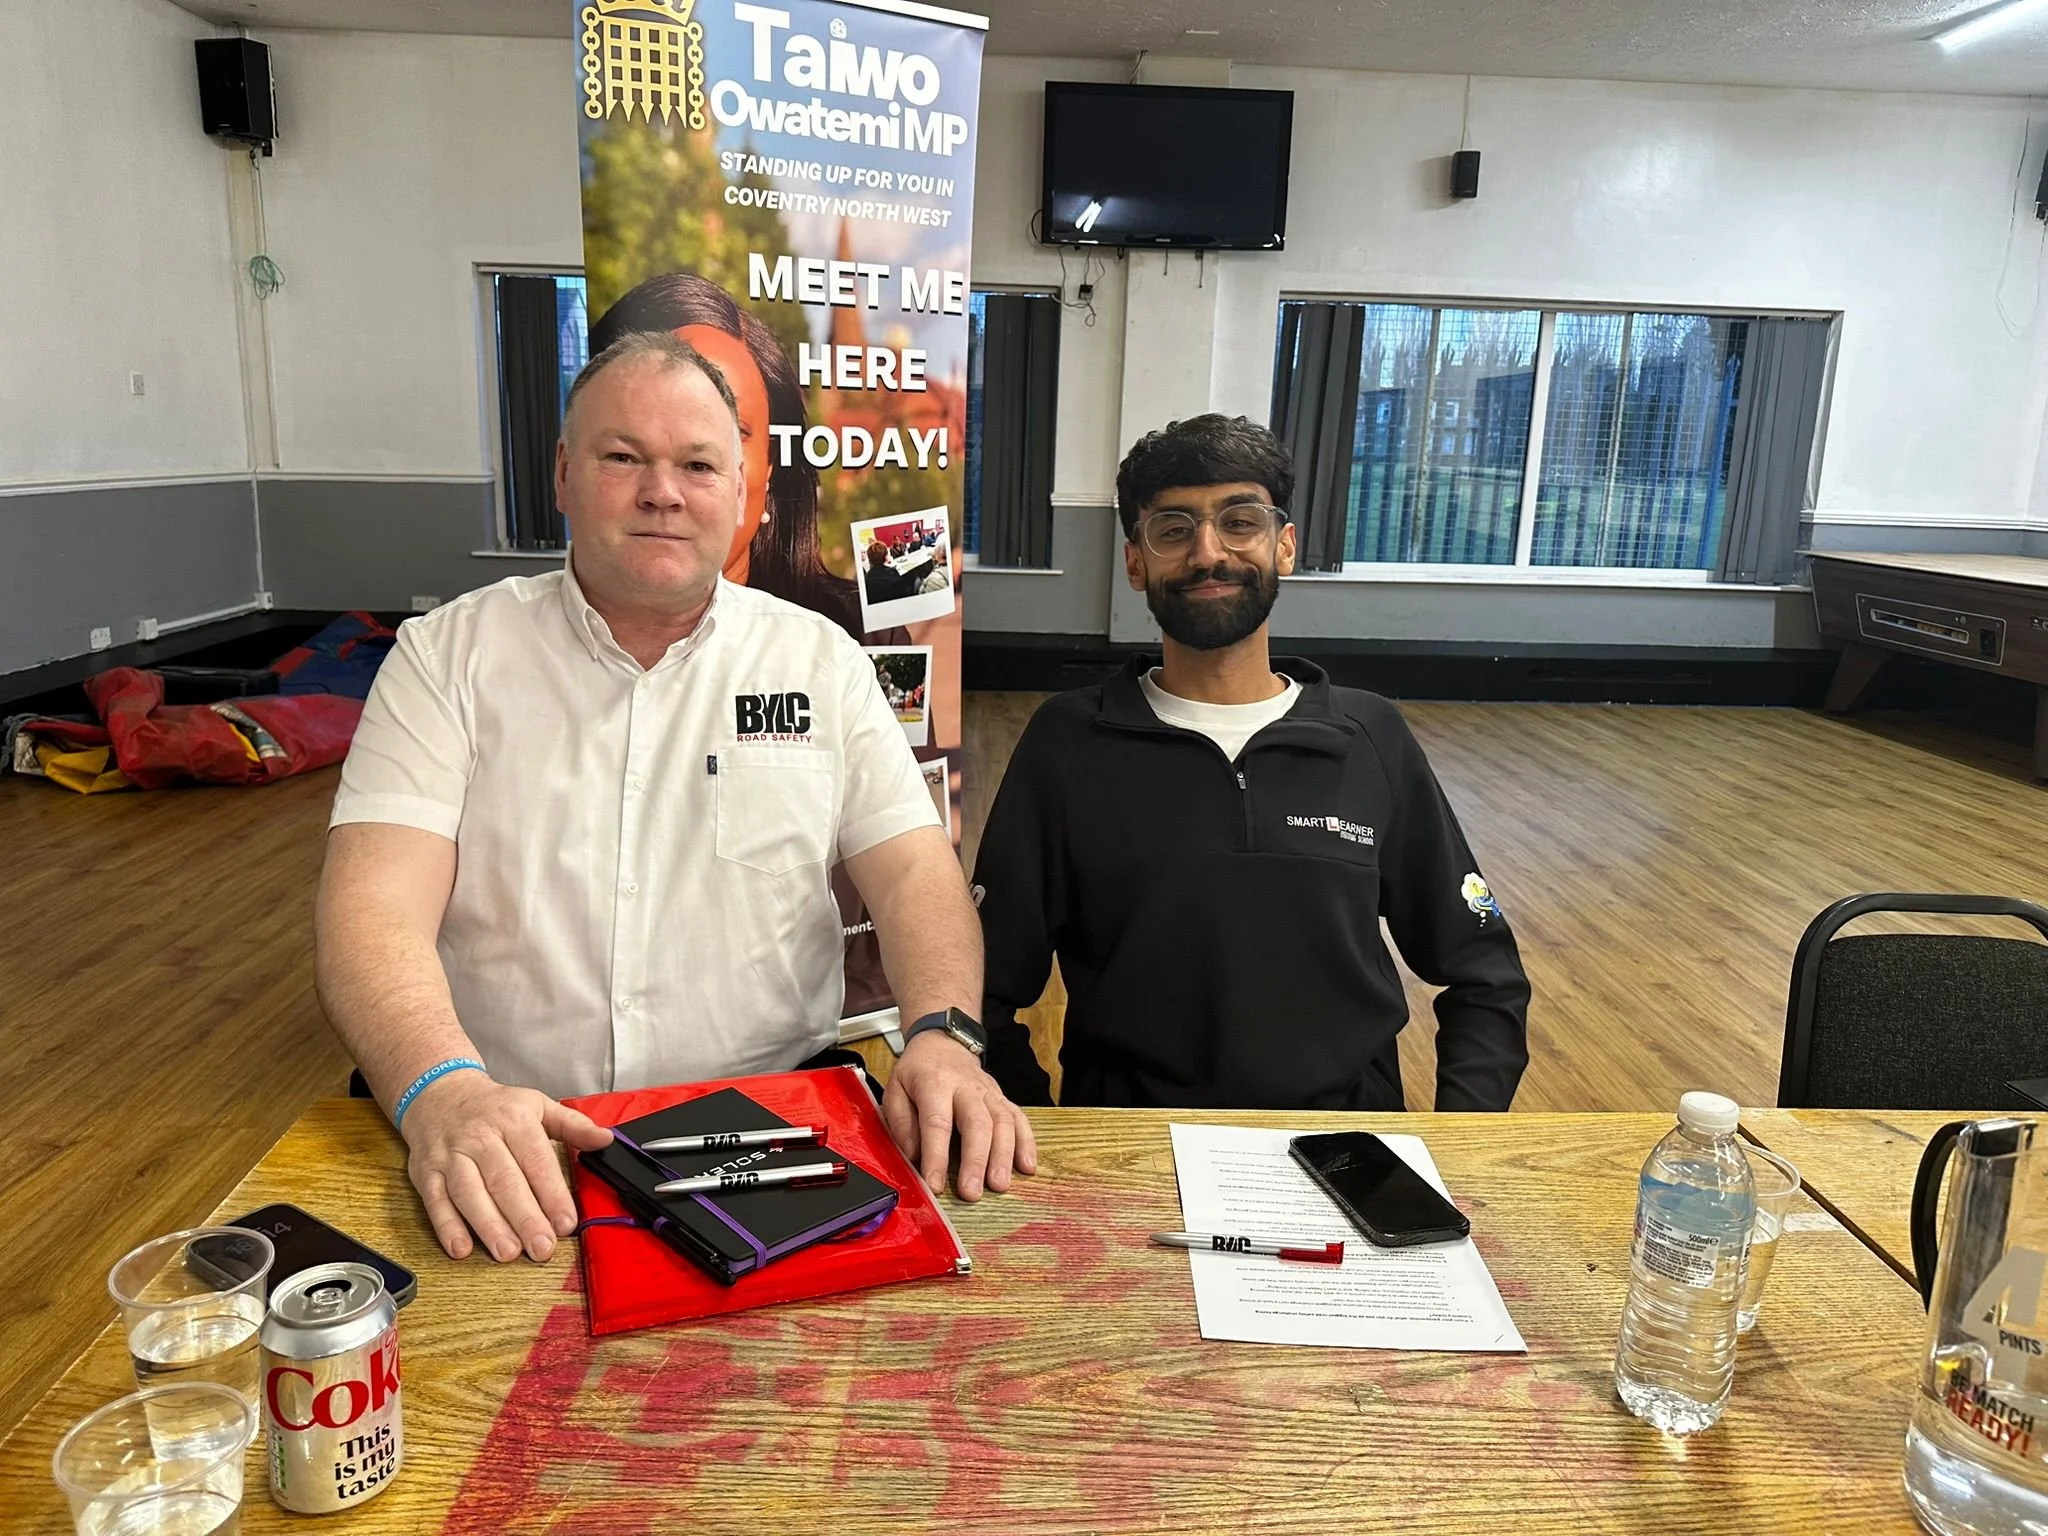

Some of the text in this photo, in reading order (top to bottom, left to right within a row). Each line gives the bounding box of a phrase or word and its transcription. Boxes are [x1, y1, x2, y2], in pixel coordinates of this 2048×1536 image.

[734, 2, 941, 106] Taiwo
[710, 80, 968, 157] Owatemi MP
[720, 151, 954, 197] STANDING UP FOR YOU IN
[724, 185, 952, 228] COVENTRY NORTH WEST
[748, 252, 964, 316] MEET ME
[798, 342, 927, 392] HERE
[768, 425, 949, 470] TODAY!
[735, 692, 811, 734] BYLC
[737, 733, 812, 743] ROAD SAFETY
[1286, 815, 1325, 828] SMART
[1999, 1330, 2042, 1356] PINTS
[266, 1346, 400, 1432] Cok
[1973, 1384, 2034, 1433] MATCH
[340, 1423, 391, 1459] This
[1946, 1384, 2030, 1458] READY!
[335, 1438, 395, 1481] is my
[337, 1457, 395, 1499] taste
